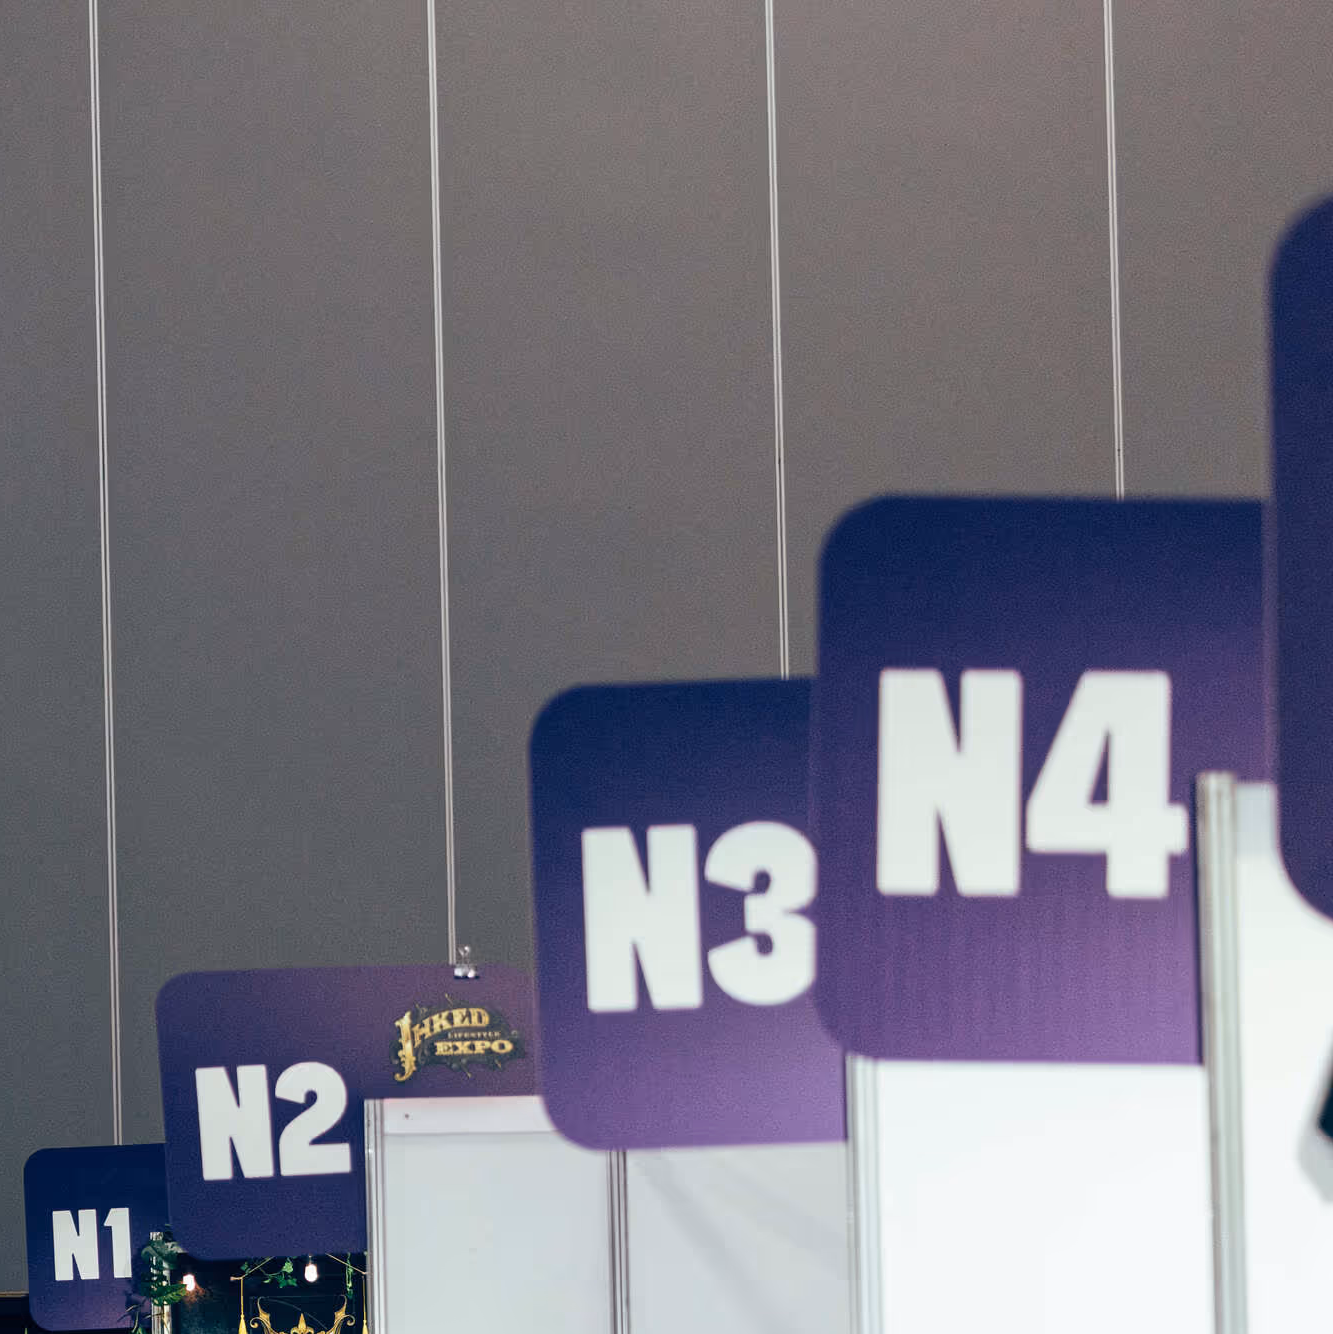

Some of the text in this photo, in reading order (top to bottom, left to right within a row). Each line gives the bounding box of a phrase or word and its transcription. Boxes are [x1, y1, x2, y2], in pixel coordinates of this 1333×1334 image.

[876, 668, 1189, 900] N4
[580, 820, 817, 1013] N3
[434, 1040, 514, 1056] EXPO
[194, 1061, 353, 1182] N2
[51, 1207, 132, 1282] N1
